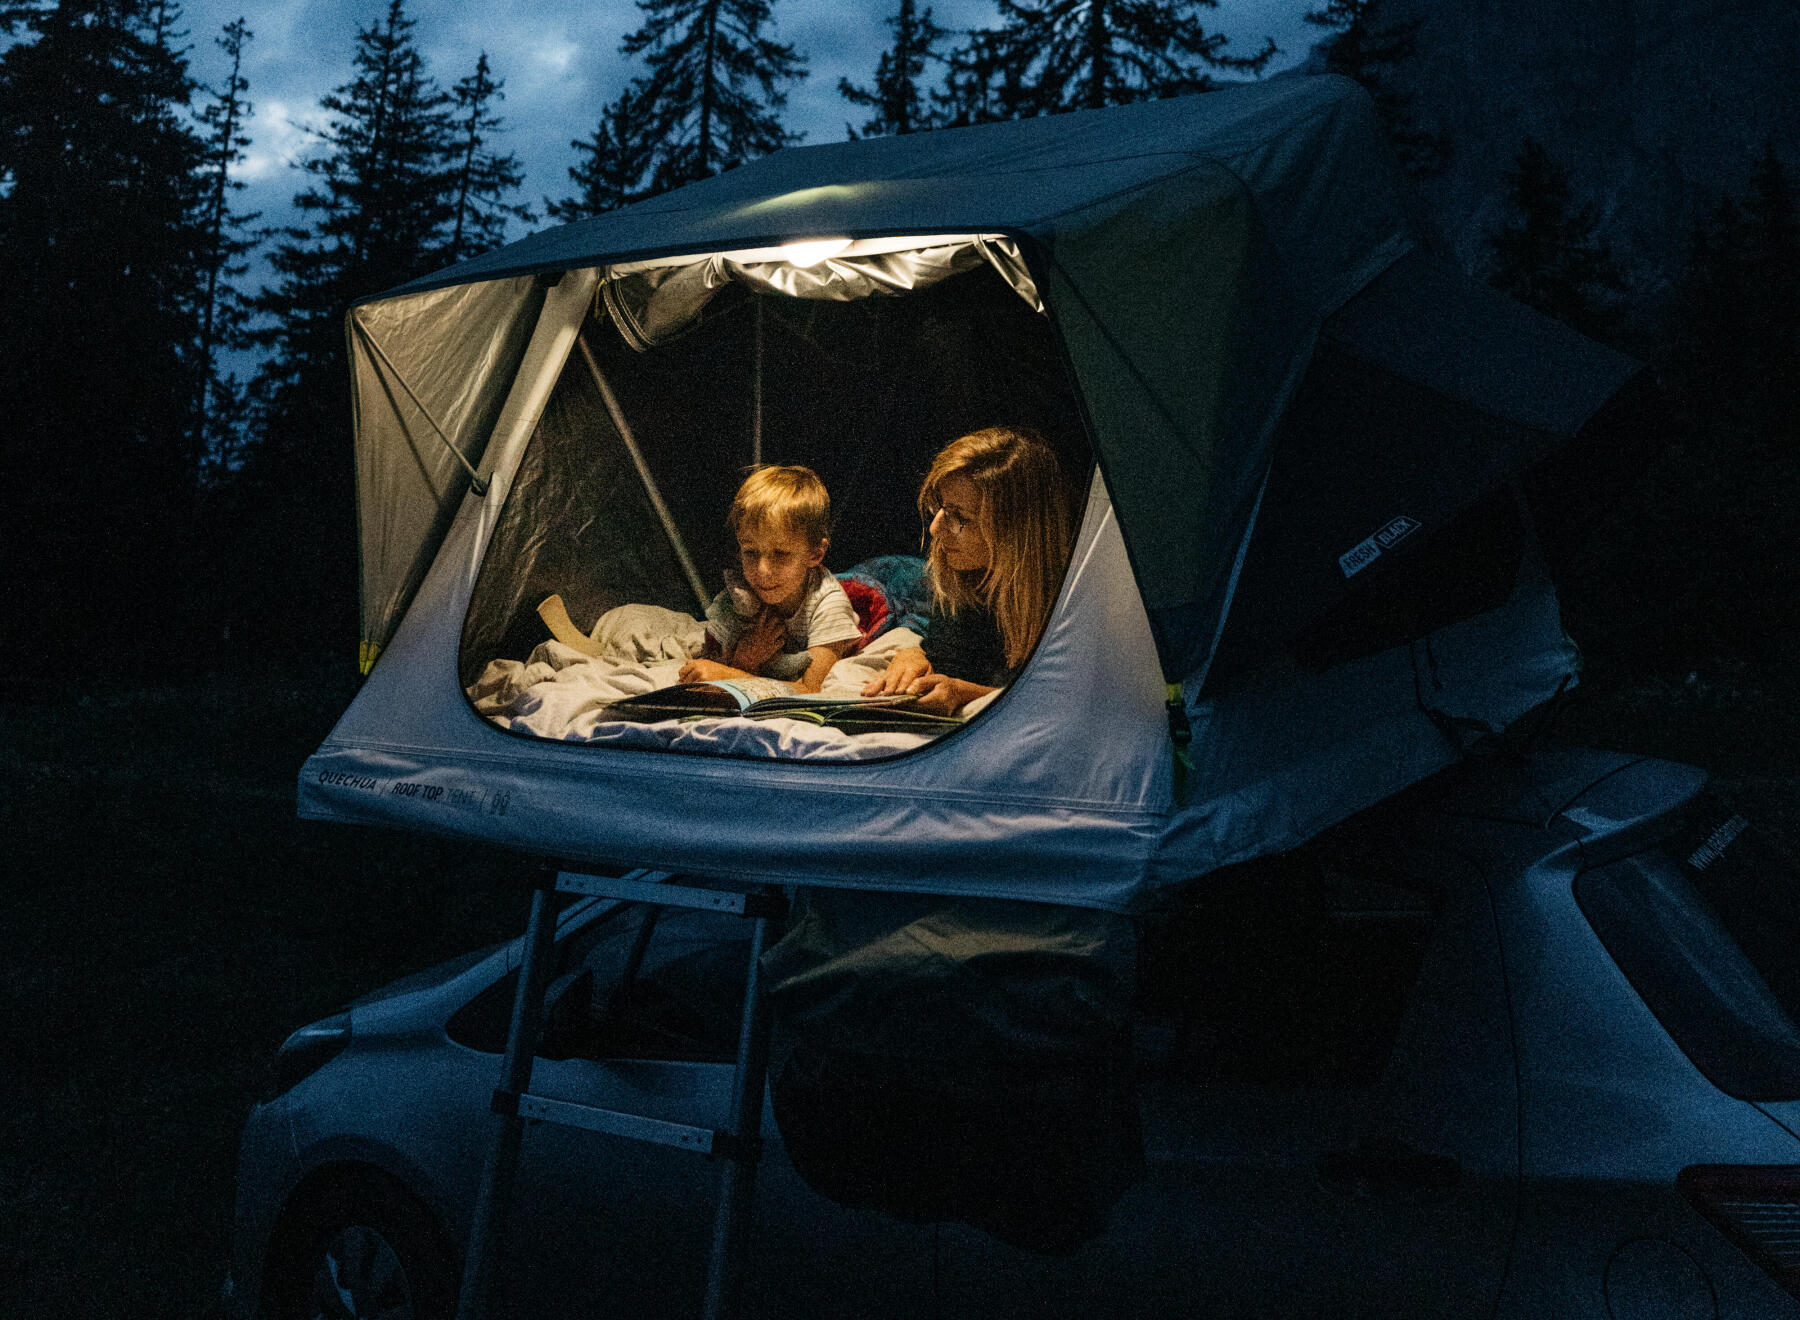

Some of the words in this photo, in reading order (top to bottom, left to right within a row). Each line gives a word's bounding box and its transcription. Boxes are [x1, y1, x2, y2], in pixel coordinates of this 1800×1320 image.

[1342, 542, 1377, 570] FRESH
[1378, 518, 1412, 545] BLACK
[318, 770, 377, 789] QUECHUA
[391, 781, 423, 798] ROOF
[421, 784, 444, 801] TOP
